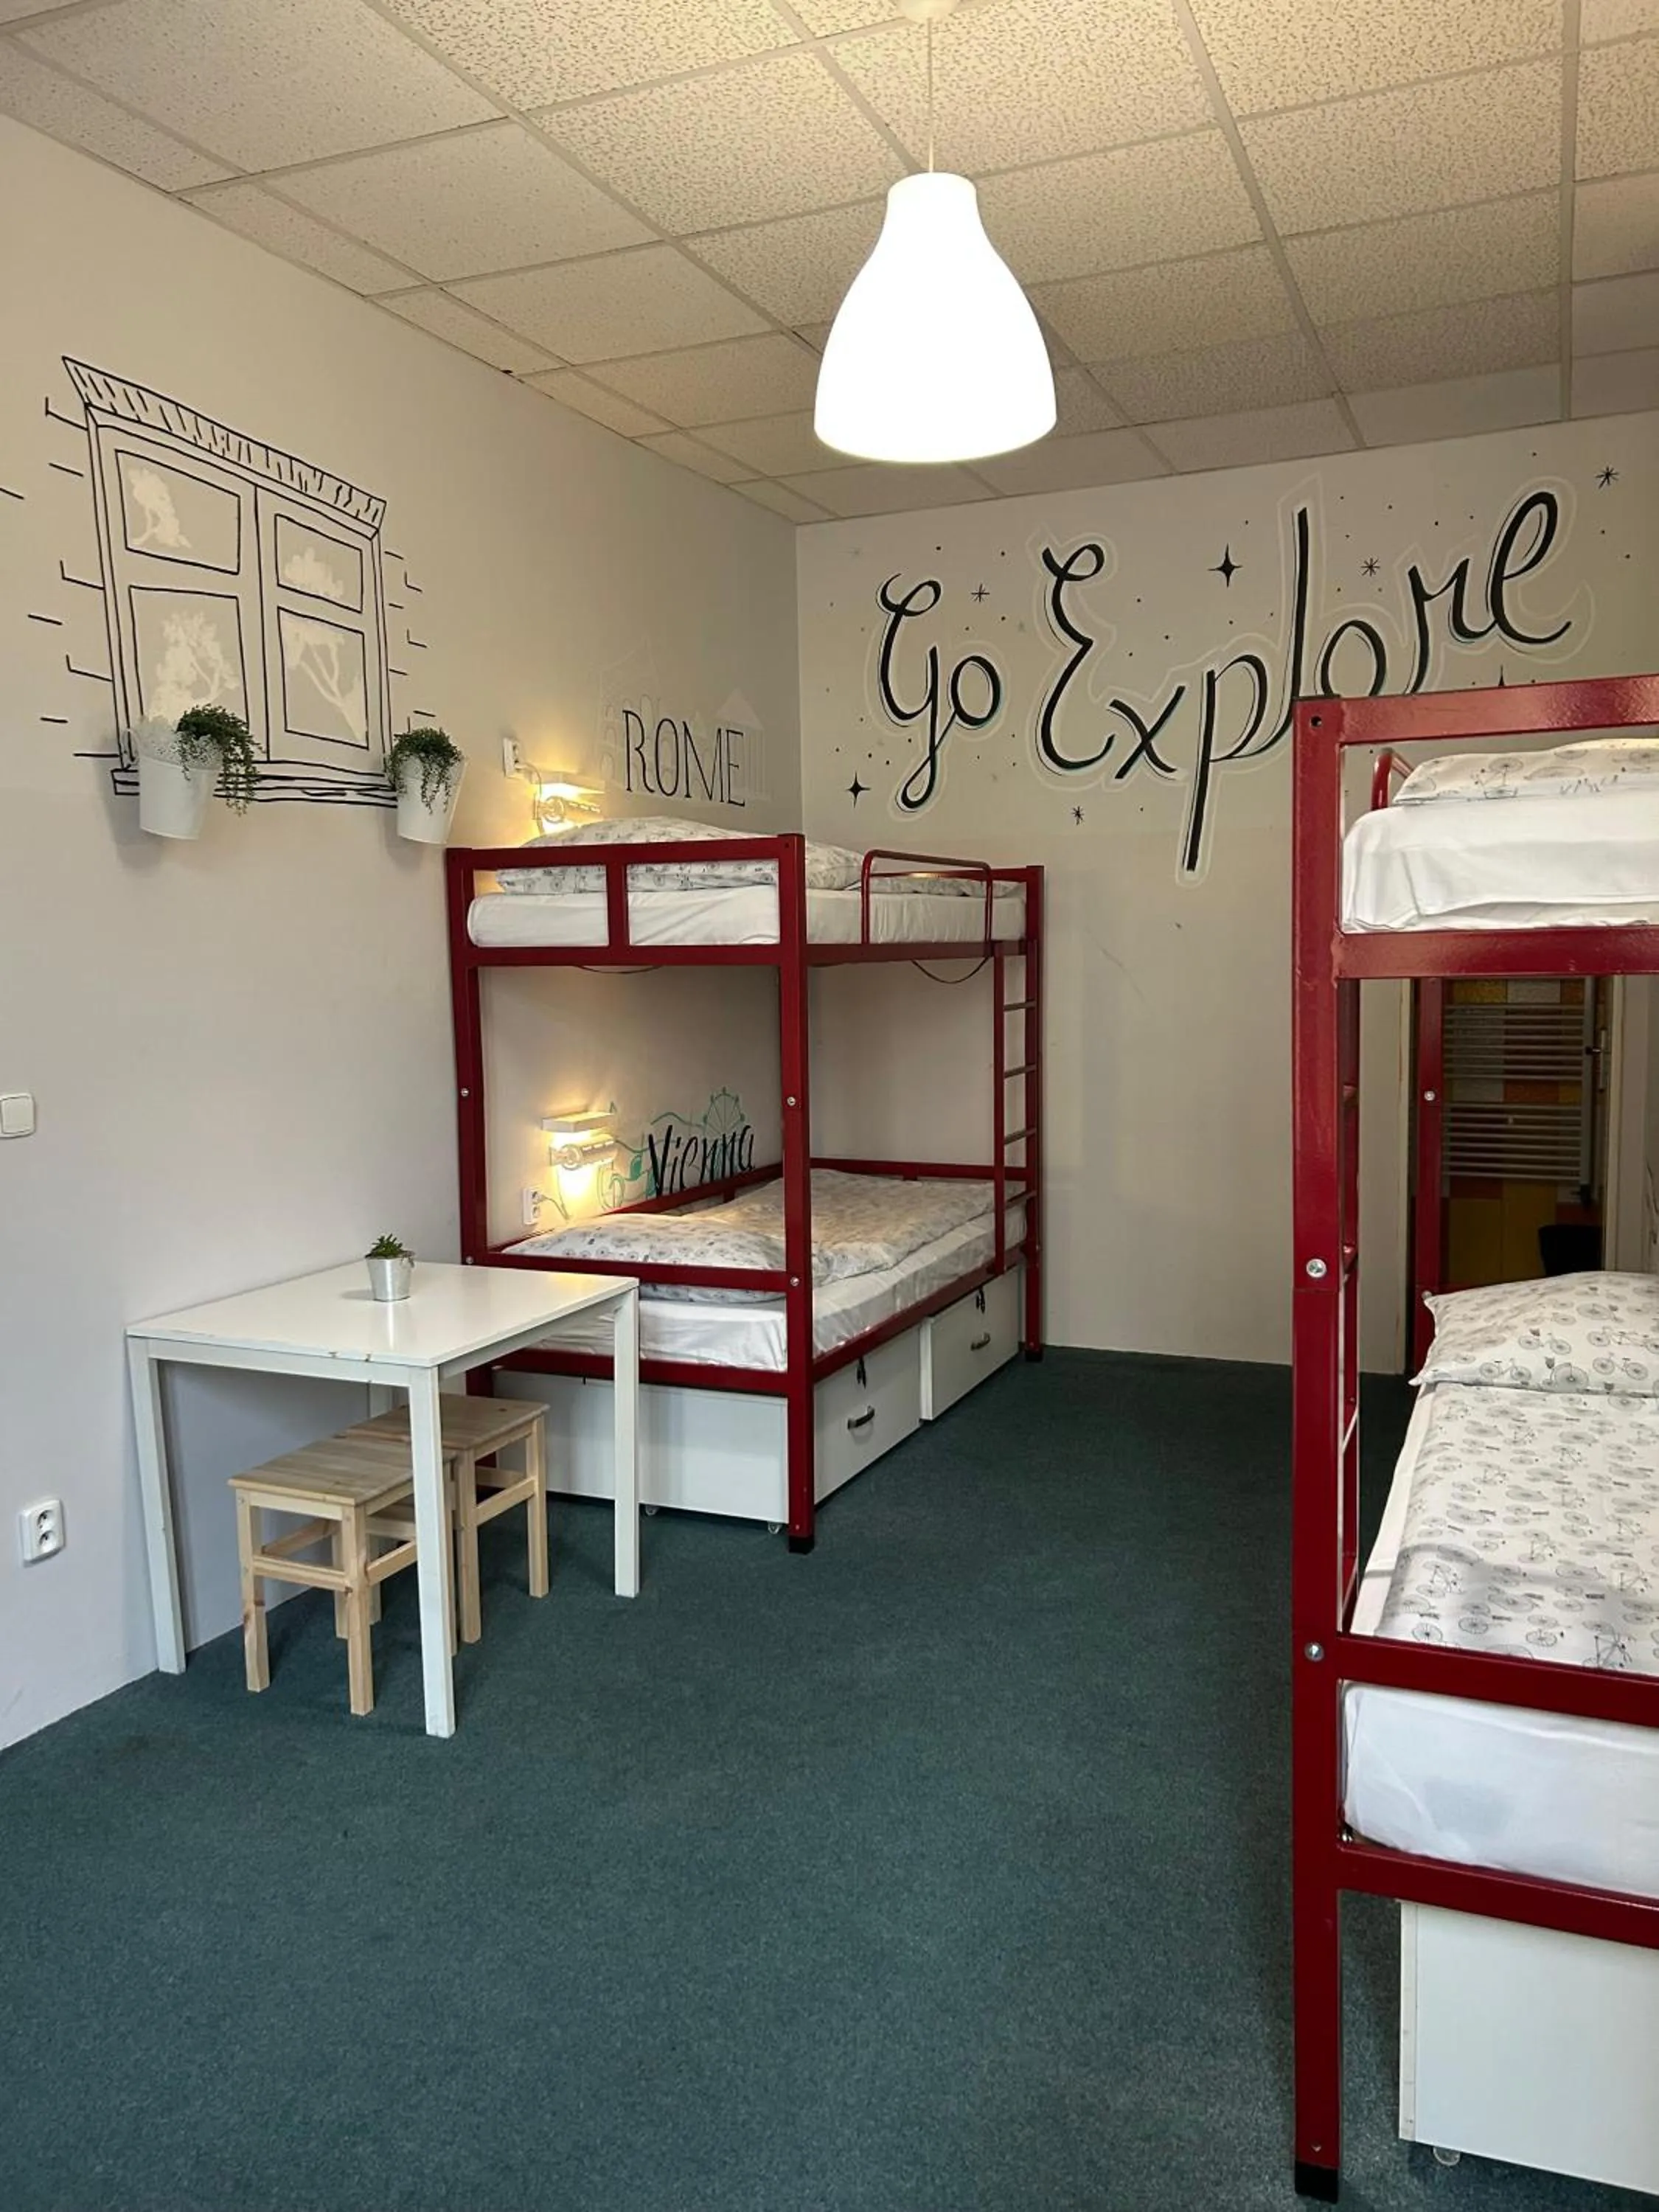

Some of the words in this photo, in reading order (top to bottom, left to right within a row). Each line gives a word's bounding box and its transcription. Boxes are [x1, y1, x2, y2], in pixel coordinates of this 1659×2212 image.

[878, 573, 1001, 812] Go
[1037, 491, 1573, 872] Explore
[622, 710, 745, 807] ROME
[649, 1124, 756, 1197] Vienna
